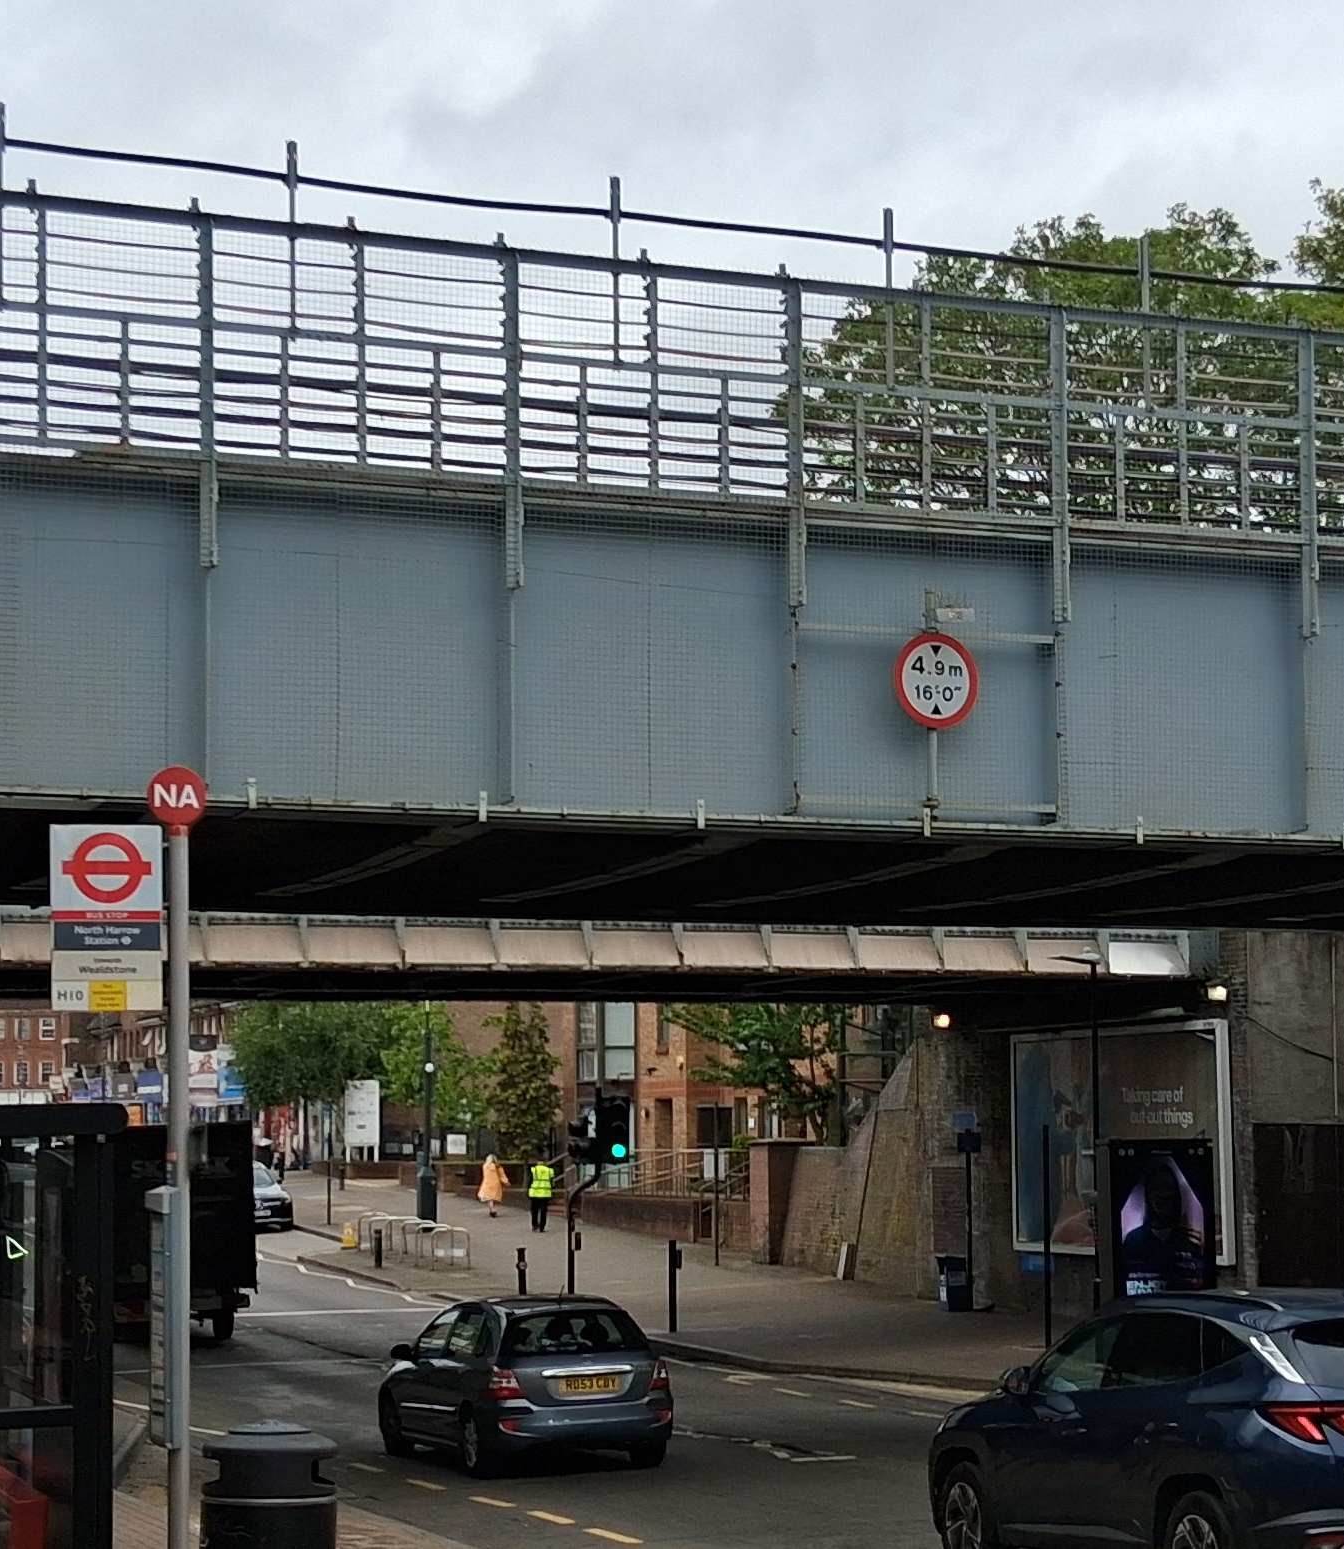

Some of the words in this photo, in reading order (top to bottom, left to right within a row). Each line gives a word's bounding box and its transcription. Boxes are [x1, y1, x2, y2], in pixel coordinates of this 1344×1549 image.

[154, 784, 200, 808] NA
[74, 925, 103, 934] North
[105, 925, 141, 934] Harrow
[84, 936, 119, 945] Station
[78, 966, 137, 974] Wealdstone
[57, 990, 84, 1001] H10
[1121, 1087, 1151, 1107] Taking
[1152, 1090, 1173, 1103] care
[1173, 1086, 1184, 1103] of
[1164, 1107, 1194, 1129] things
